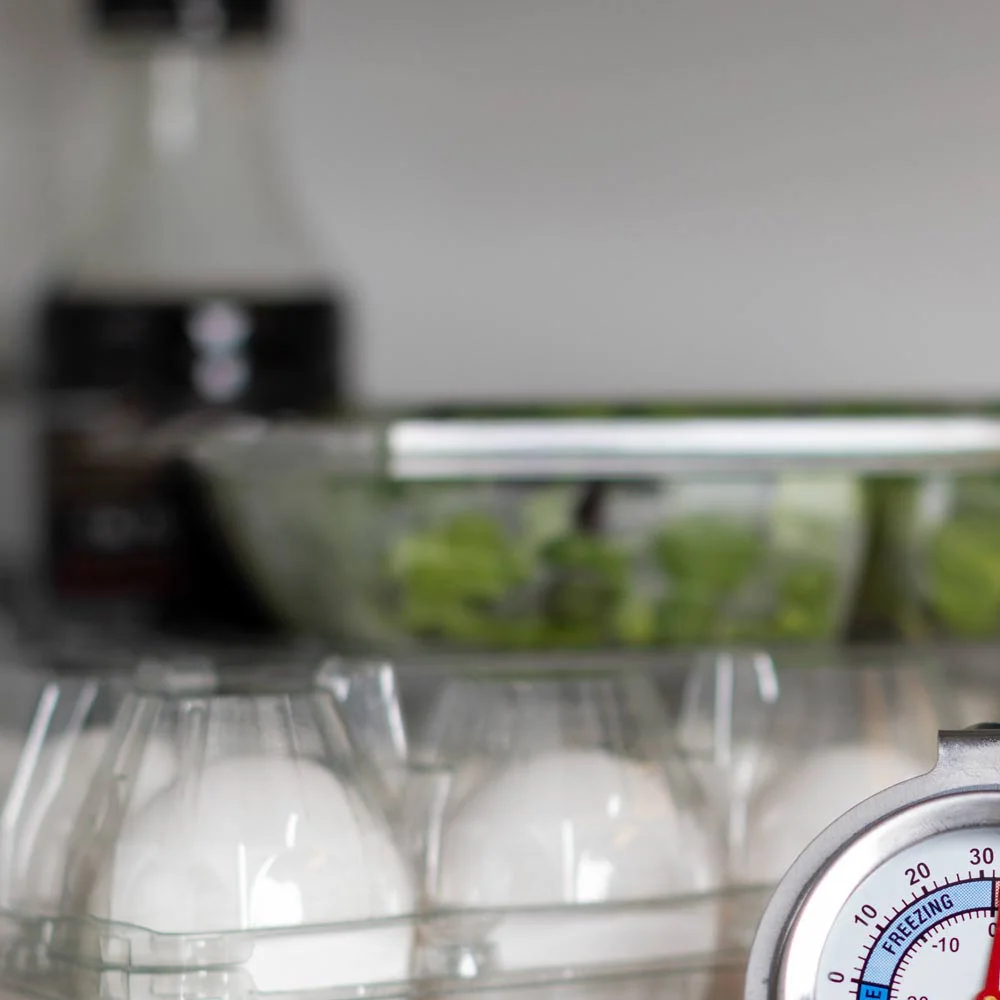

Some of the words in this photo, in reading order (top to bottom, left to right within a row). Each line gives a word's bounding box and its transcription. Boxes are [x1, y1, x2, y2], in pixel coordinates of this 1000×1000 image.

[969, 847, 994, 865] 30
[904, 862, 931, 886] 20
[854, 904, 877, 927] 10
[882, 893, 954, 956] FREEZING
[932, 937, 960, 952] -10
[827, 971, 845, 983] 0
